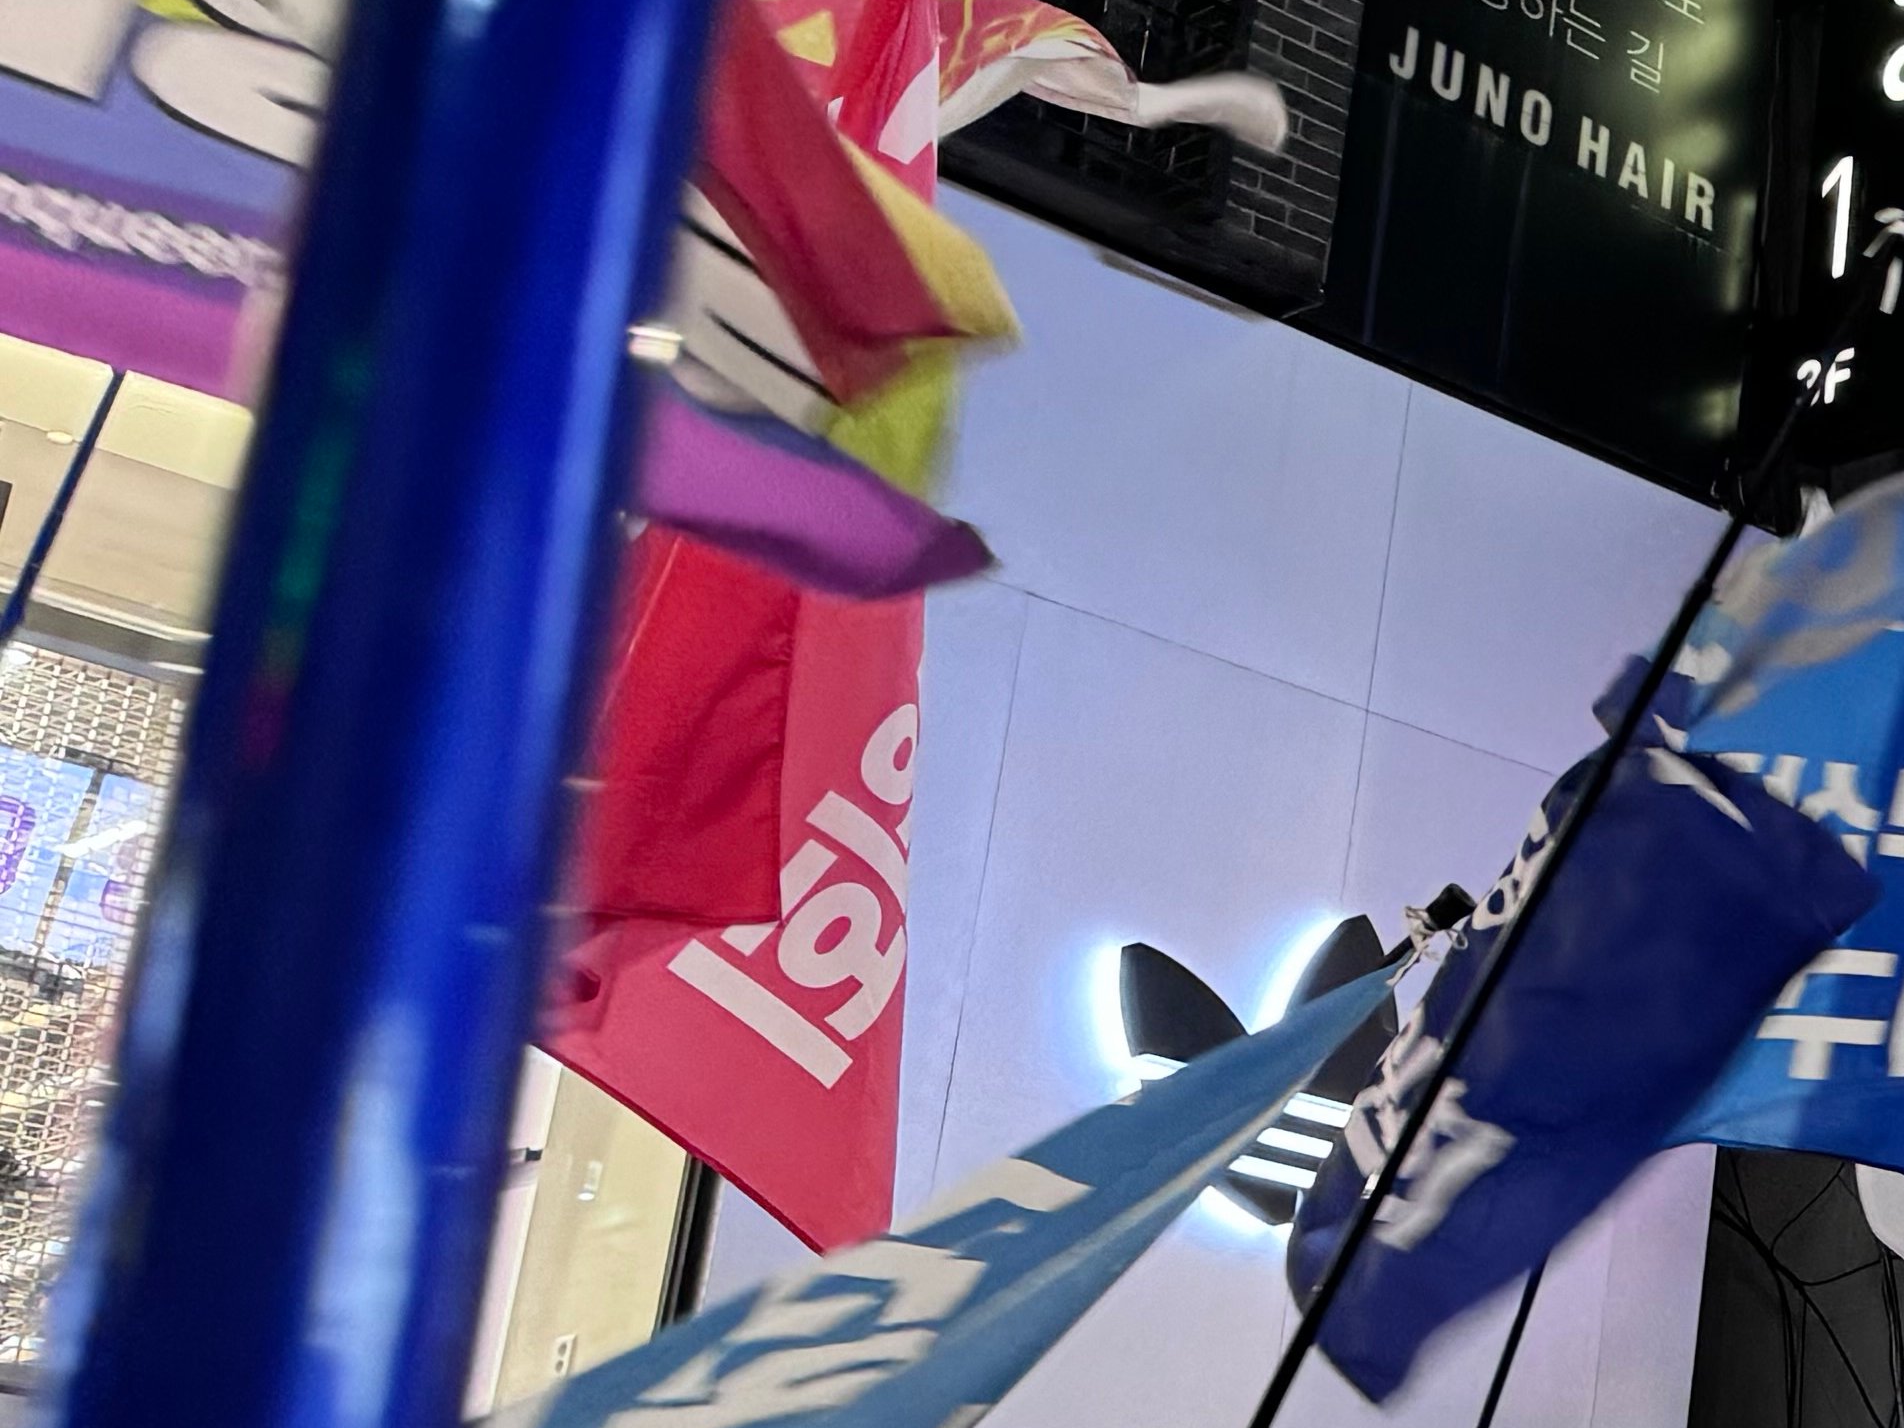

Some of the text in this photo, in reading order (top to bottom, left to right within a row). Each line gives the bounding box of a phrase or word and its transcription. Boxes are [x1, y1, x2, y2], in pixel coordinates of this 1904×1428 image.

[1388, 26, 1718, 235] JUNO HAIR
[1624, 30, 1665, 98] 길
